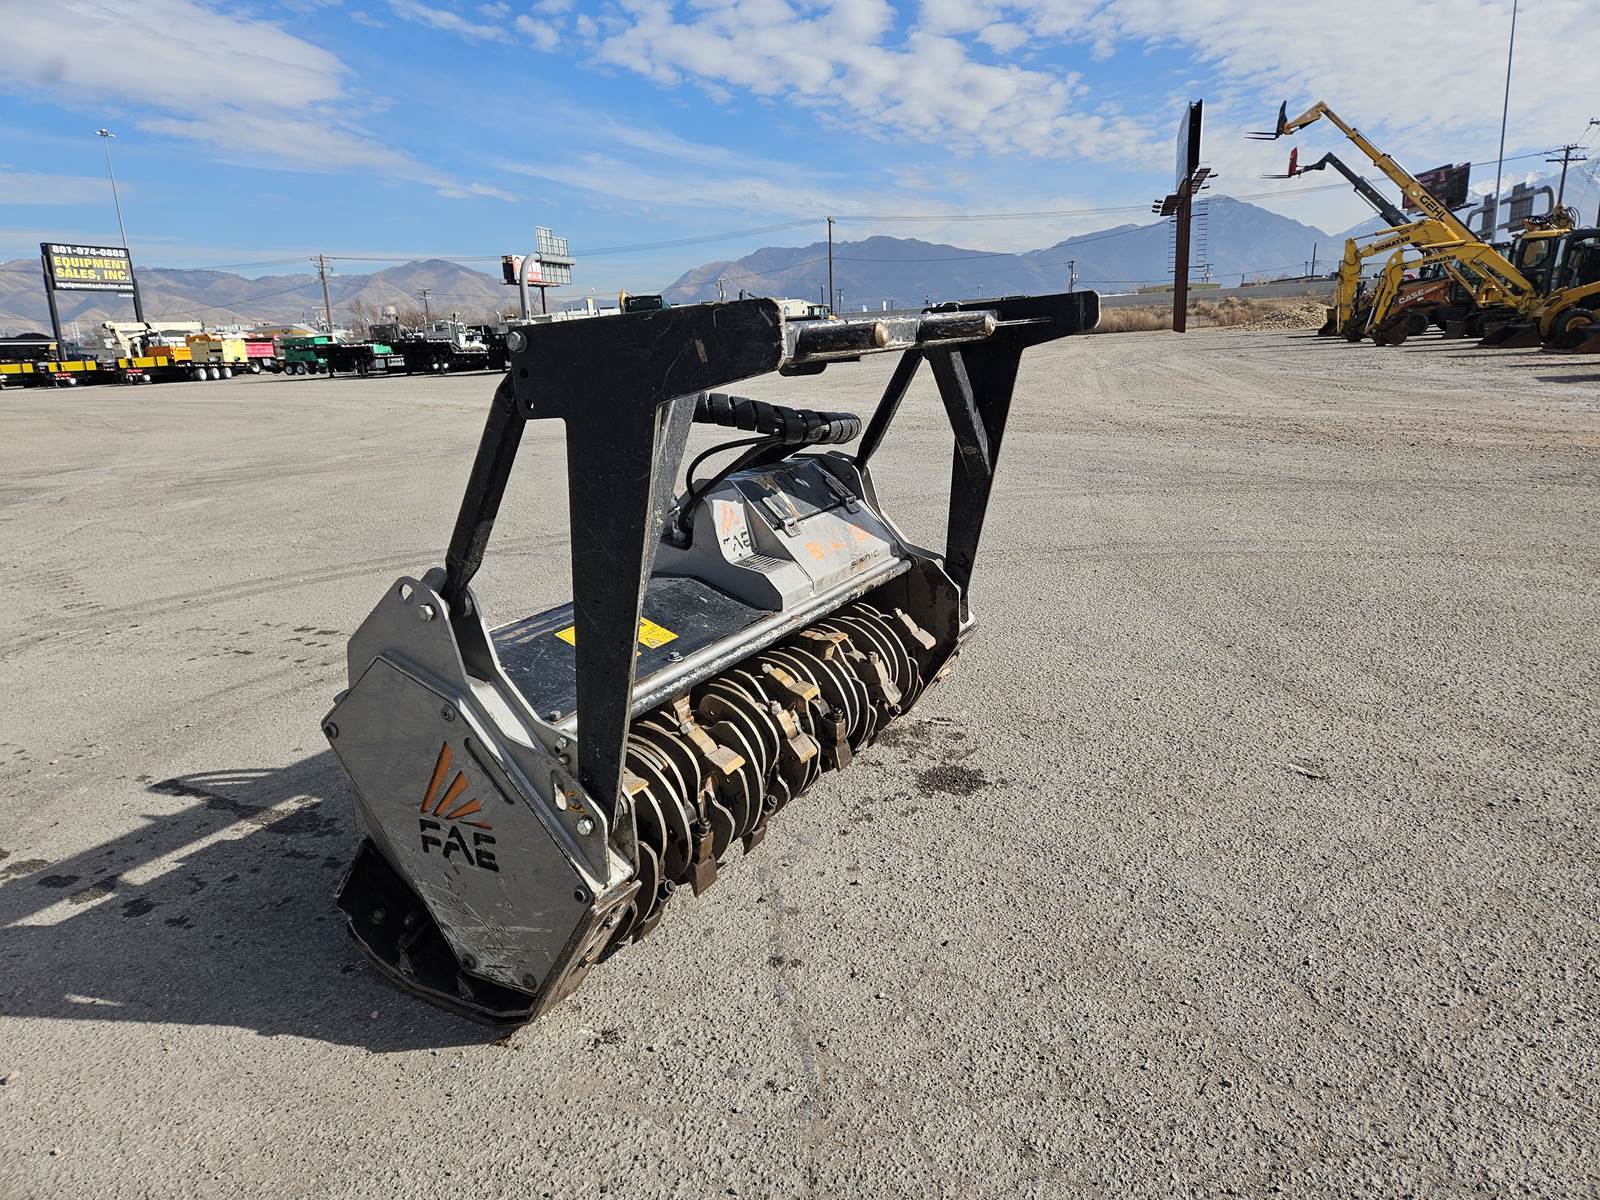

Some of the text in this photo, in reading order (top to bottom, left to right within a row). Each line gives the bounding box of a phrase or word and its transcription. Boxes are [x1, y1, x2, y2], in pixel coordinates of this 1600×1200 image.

[1419, 195, 1446, 222] GEHL
[1374, 236, 1410, 252] KOMATSU
[53, 256, 127, 270] EQUIPMENT
[1423, 255, 1456, 265] KOMATSU
[55, 268, 130, 281] SALES, INC.
[1399, 289, 1425, 304] CASE
[419, 818, 500, 873] FAE
